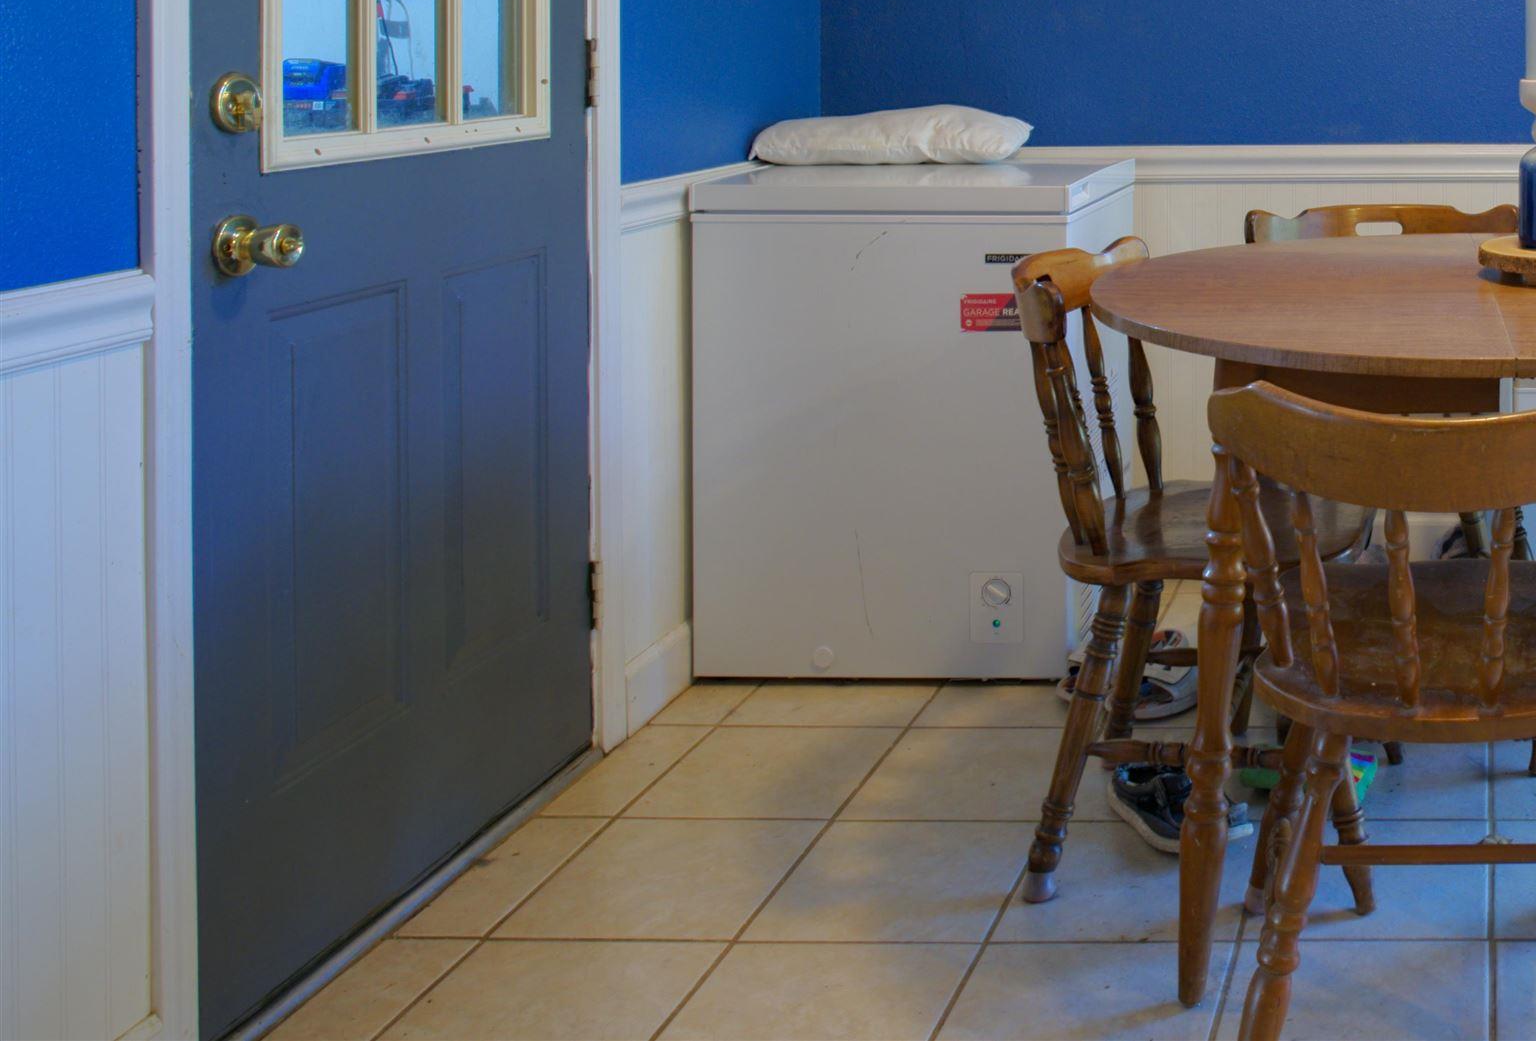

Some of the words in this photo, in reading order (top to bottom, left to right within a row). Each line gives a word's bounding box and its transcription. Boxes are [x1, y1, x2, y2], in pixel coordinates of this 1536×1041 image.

[986, 254, 1025, 263] FRIGIDA
[963, 307, 1000, 317] GARAGE
[1002, 307, 1020, 317] REA
